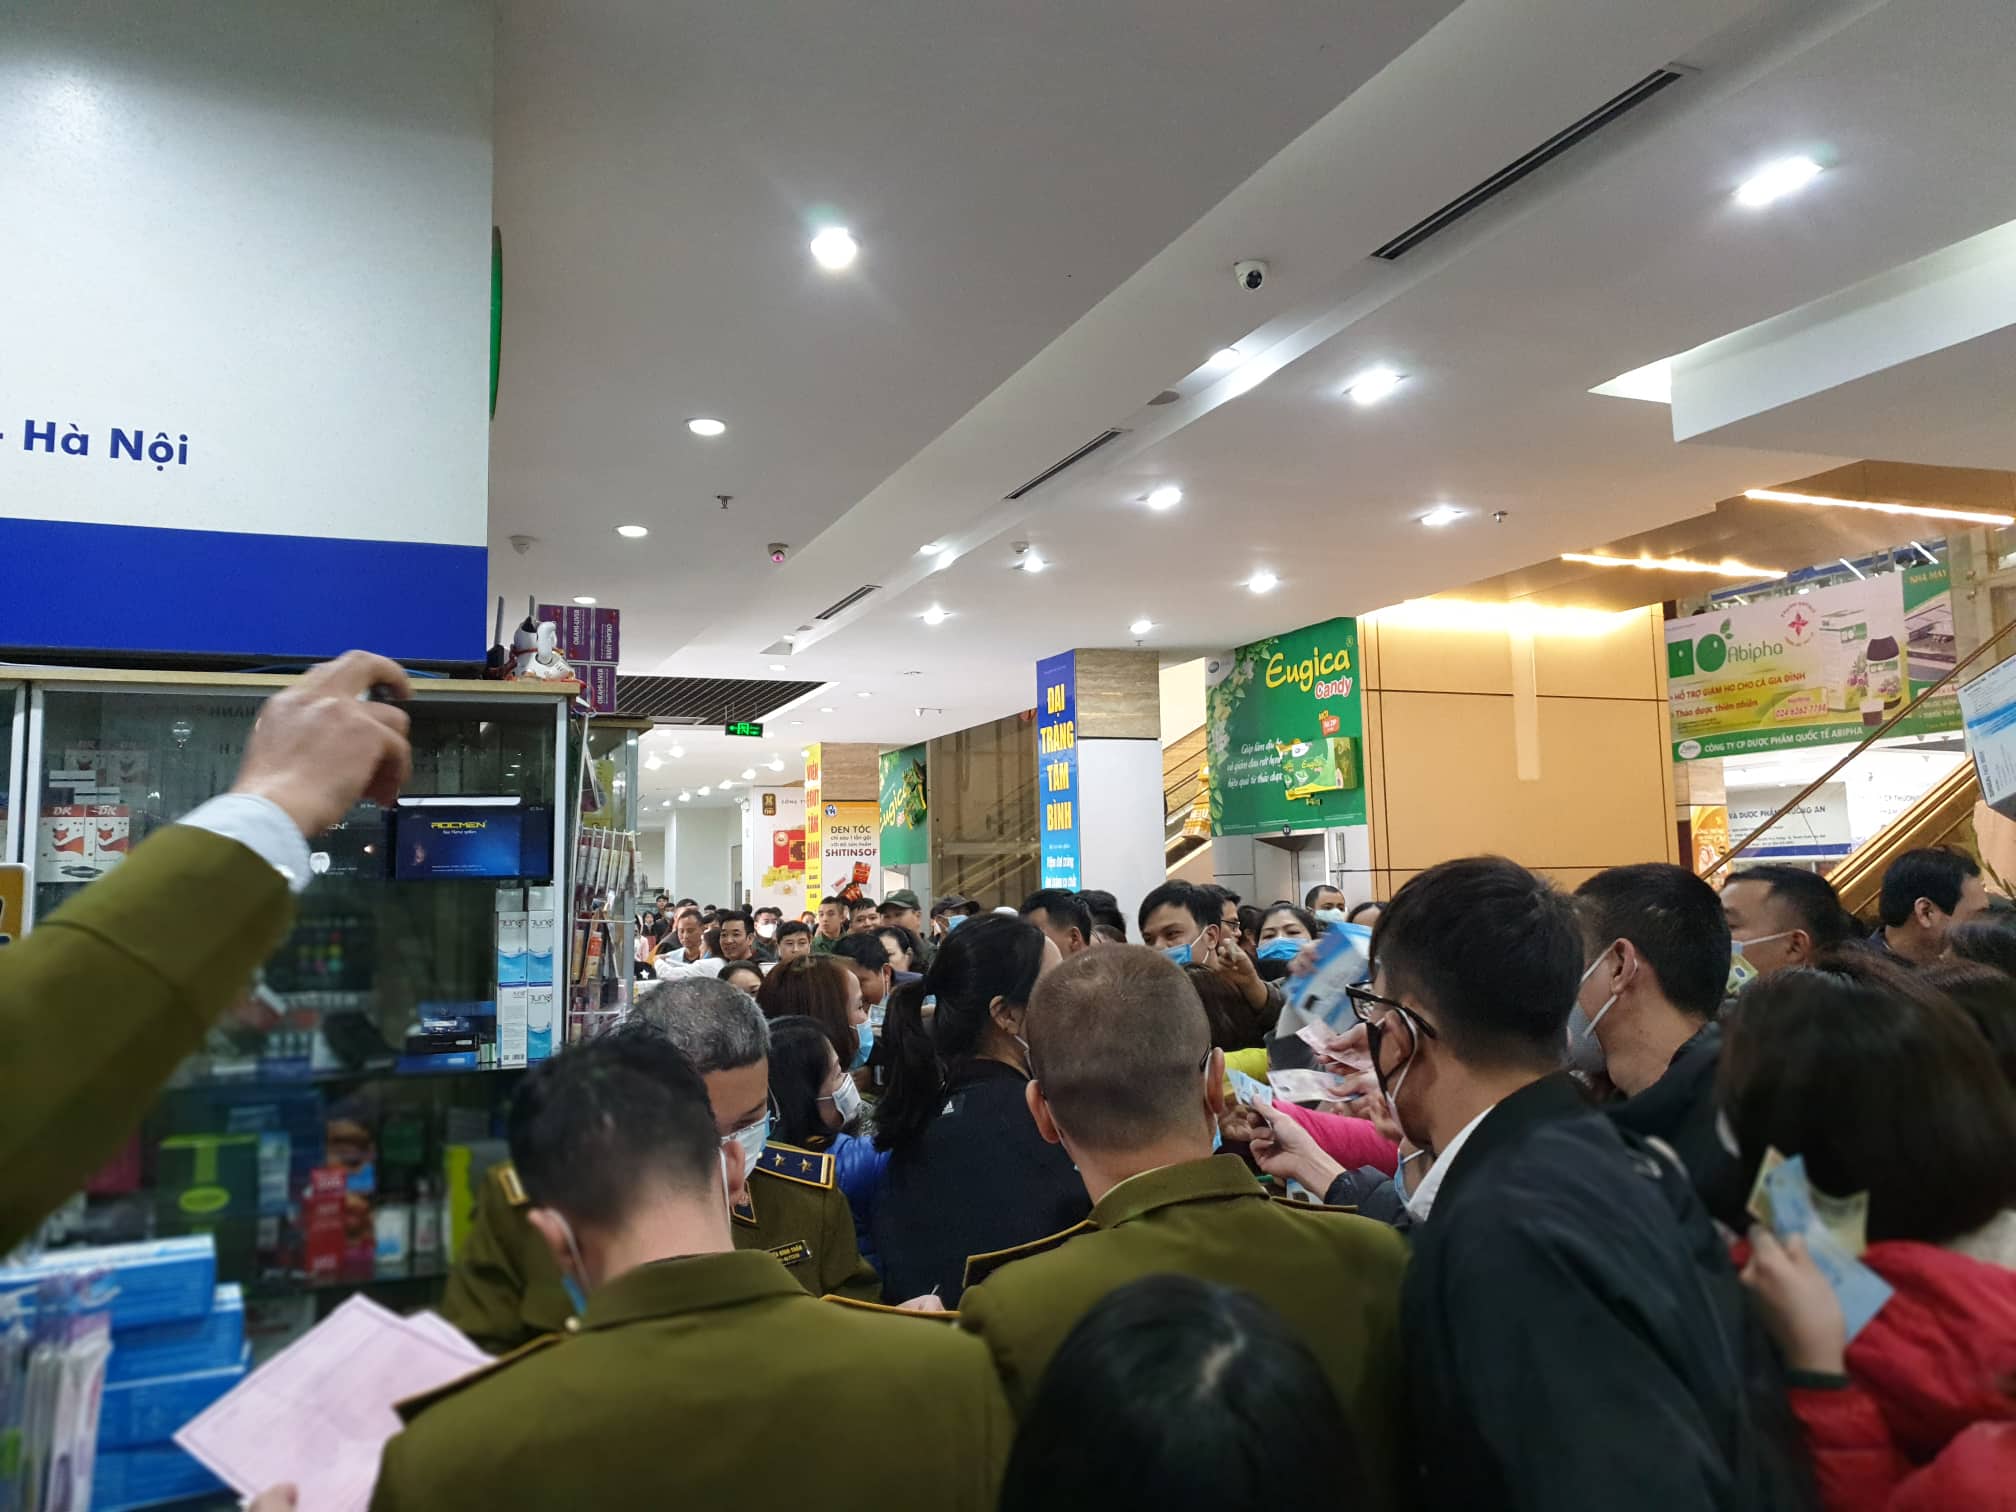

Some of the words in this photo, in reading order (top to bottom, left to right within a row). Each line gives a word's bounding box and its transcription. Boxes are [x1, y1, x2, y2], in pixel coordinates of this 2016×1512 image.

[24, 419, 89, 456] Hà
[110, 428, 188, 471] Nội
[1727, 640, 1784, 663] Abipha
[1266, 646, 1350, 692] Eugica
[1047, 683, 1065, 718] ĐẠI
[1315, 676, 1352, 699] Candy
[1040, 720, 1074, 754] TRÀNG
[1047, 758, 1070, 792] TÂM
[831, 825, 850, 834] ĐEN
[853, 824, 872, 834] TÓC
[1047, 798, 1073, 832] BÌNH
